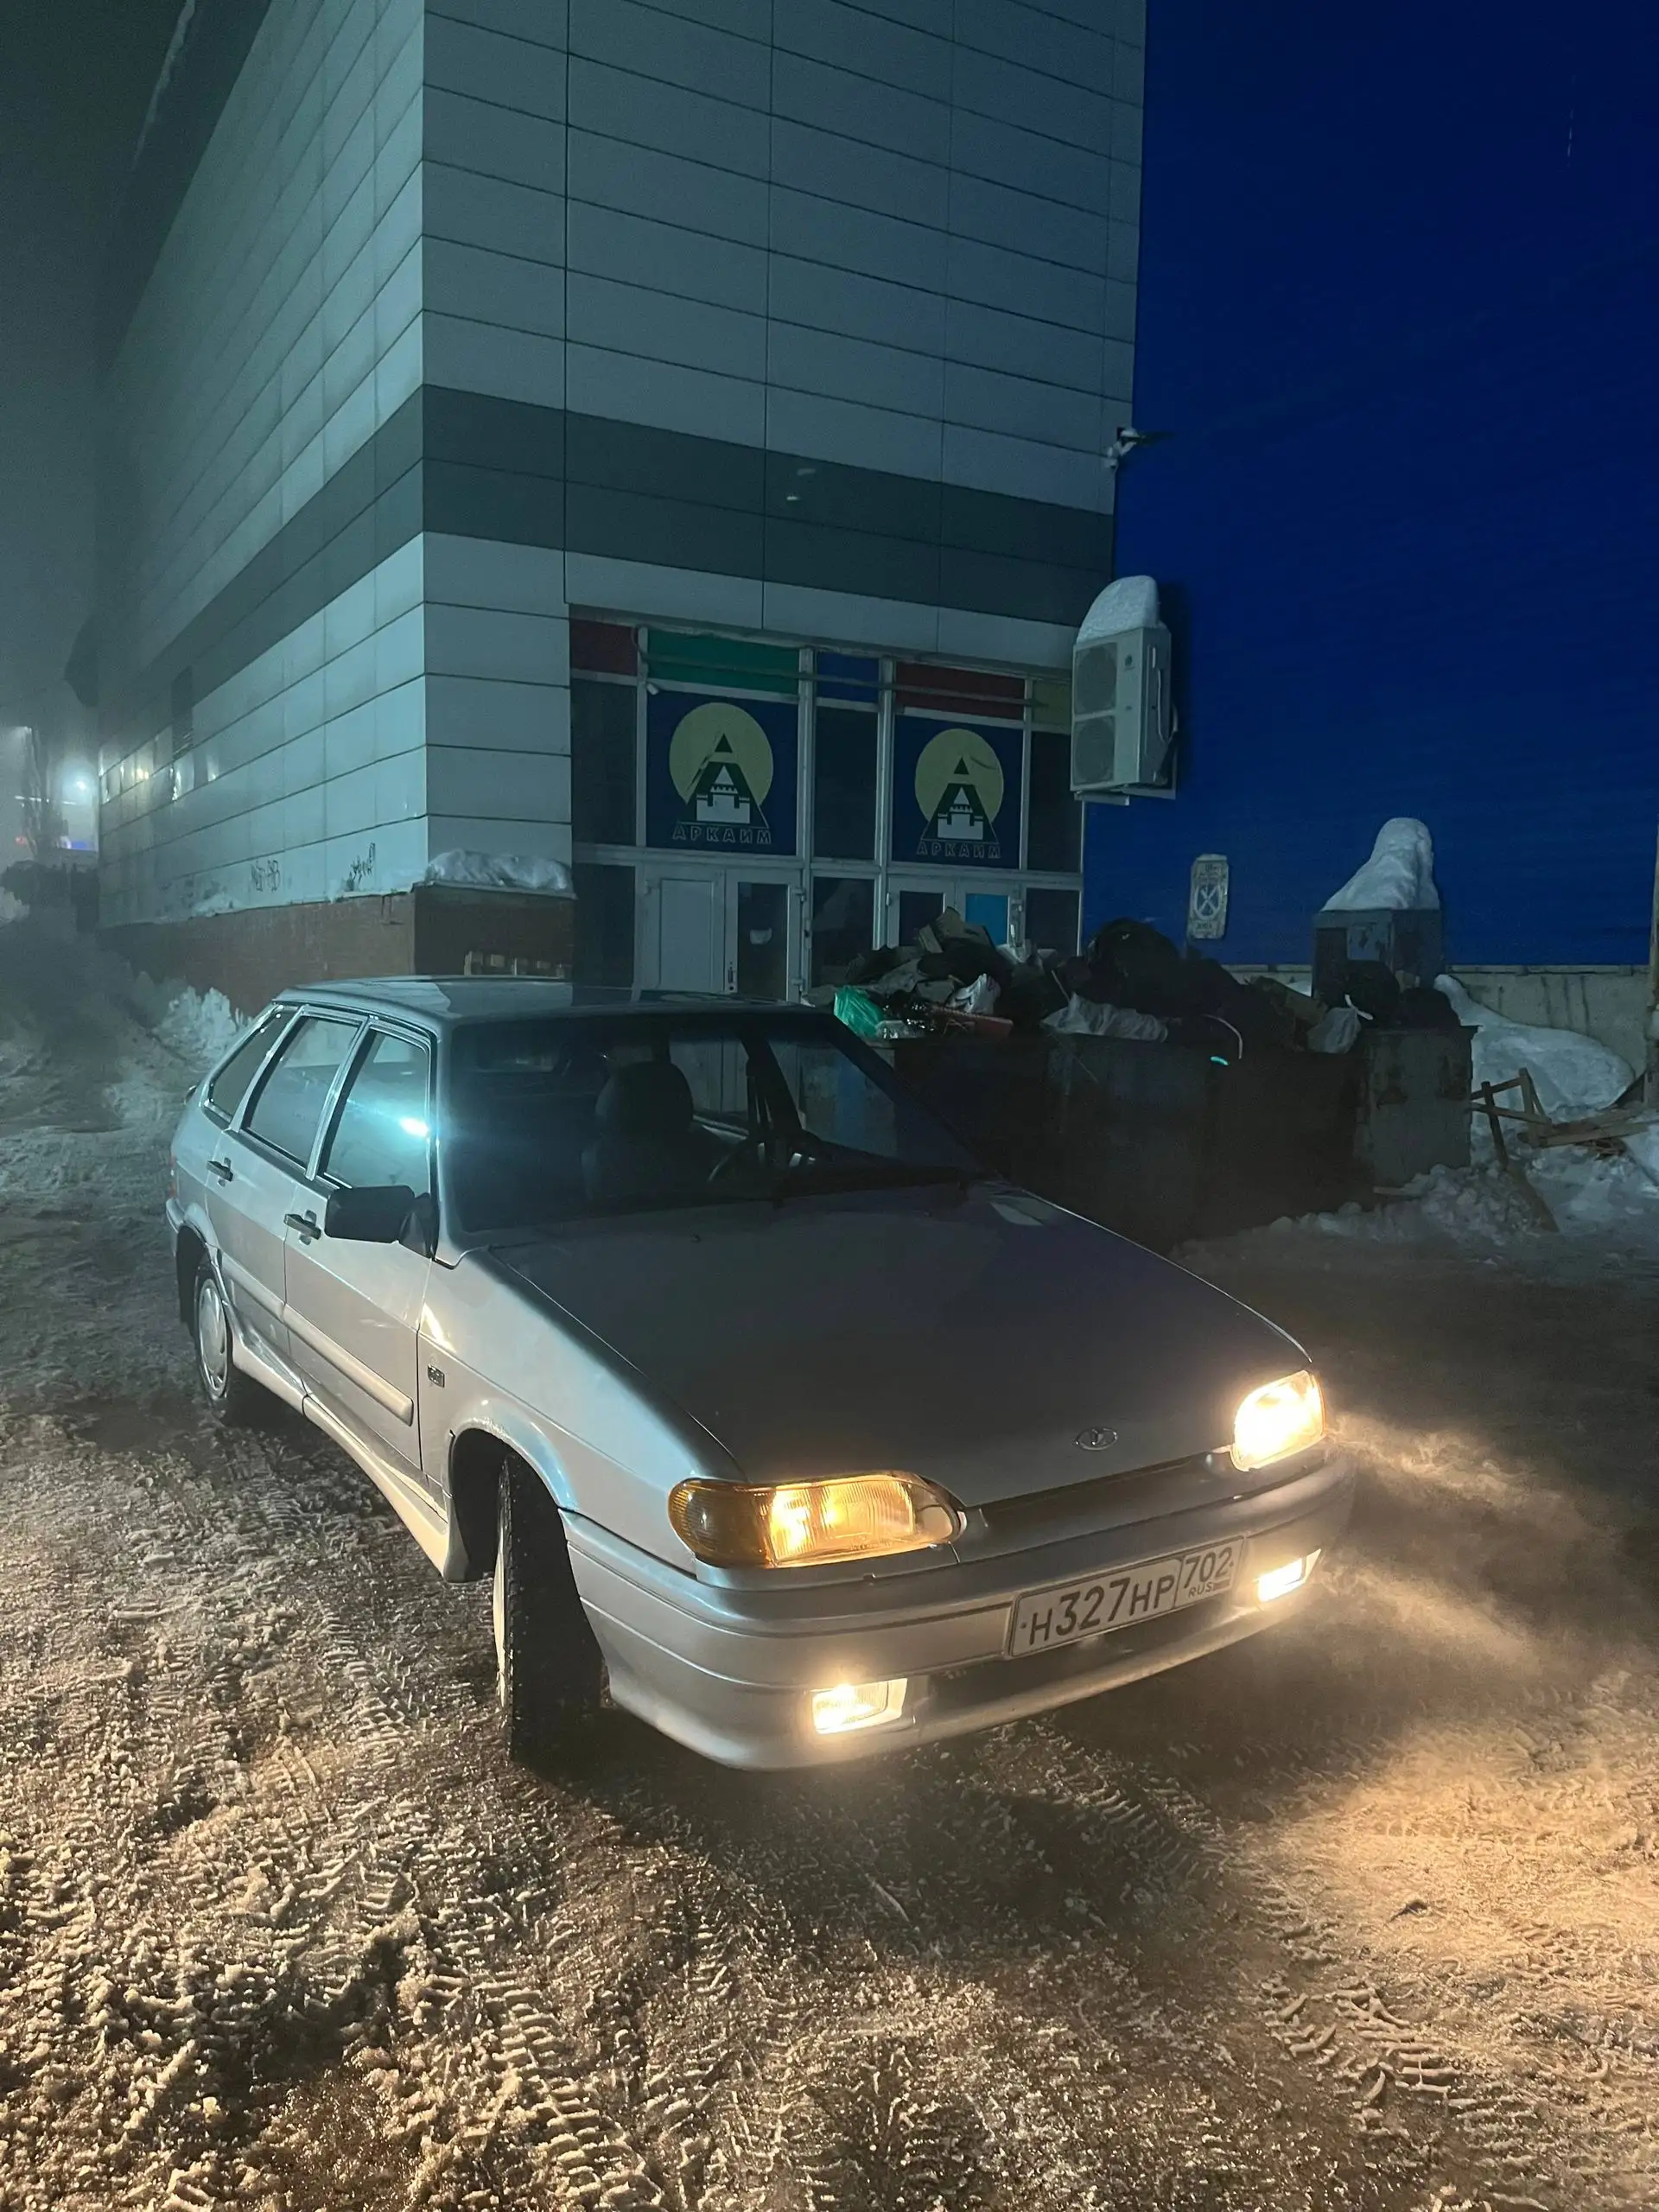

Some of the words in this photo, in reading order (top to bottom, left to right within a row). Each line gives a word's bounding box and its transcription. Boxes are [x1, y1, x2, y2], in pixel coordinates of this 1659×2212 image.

[672, 822, 772, 844] АРКАИМ
[916, 842, 1001, 859] АРКАИМ
[1184, 1546, 1233, 1589] 702
[1188, 1581, 1213, 1598] RUS
